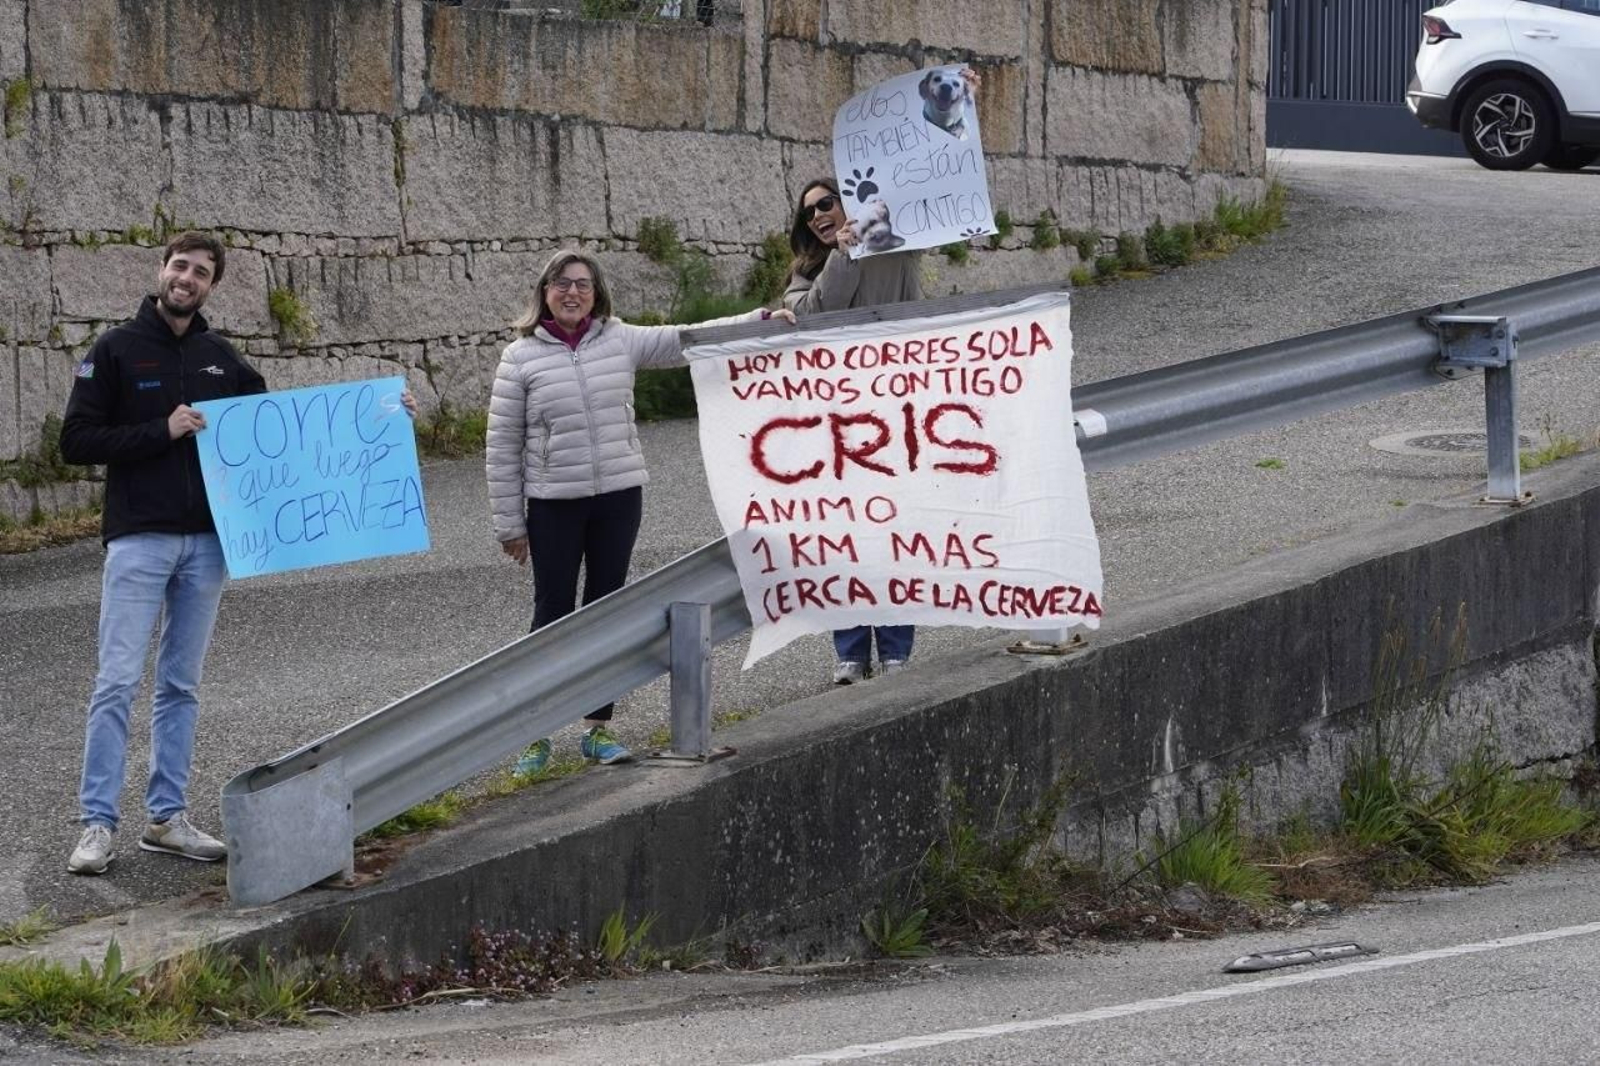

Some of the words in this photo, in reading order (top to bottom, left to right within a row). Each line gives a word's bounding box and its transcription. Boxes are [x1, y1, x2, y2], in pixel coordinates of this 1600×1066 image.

[837, 117, 930, 163] TAMBIÉN
[896, 192, 987, 235] CONTIGO
[728, 351, 782, 380] HOY
[795, 347, 836, 369] NO
[844, 337, 960, 370] CORRES
[965, 322, 1052, 361] SOLA
[731, 374, 860, 404] VAMOS
[871, 366, 1023, 398] CONTIGO
[749, 402, 998, 484] CRIS
[239, 463, 299, 512] que
[743, 493, 897, 530] ÁNIMO
[223, 517, 274, 571] hay
[275, 476, 427, 544] CERVEZA
[752, 537, 779, 573] 1
[788, 533, 859, 568] KM
[890, 522, 999, 569] MÁS
[762, 576, 877, 623] CERCA
[889, 579, 923, 604] DE
[932, 583, 973, 612] LA
[979, 580, 1102, 619] CERVEZA
